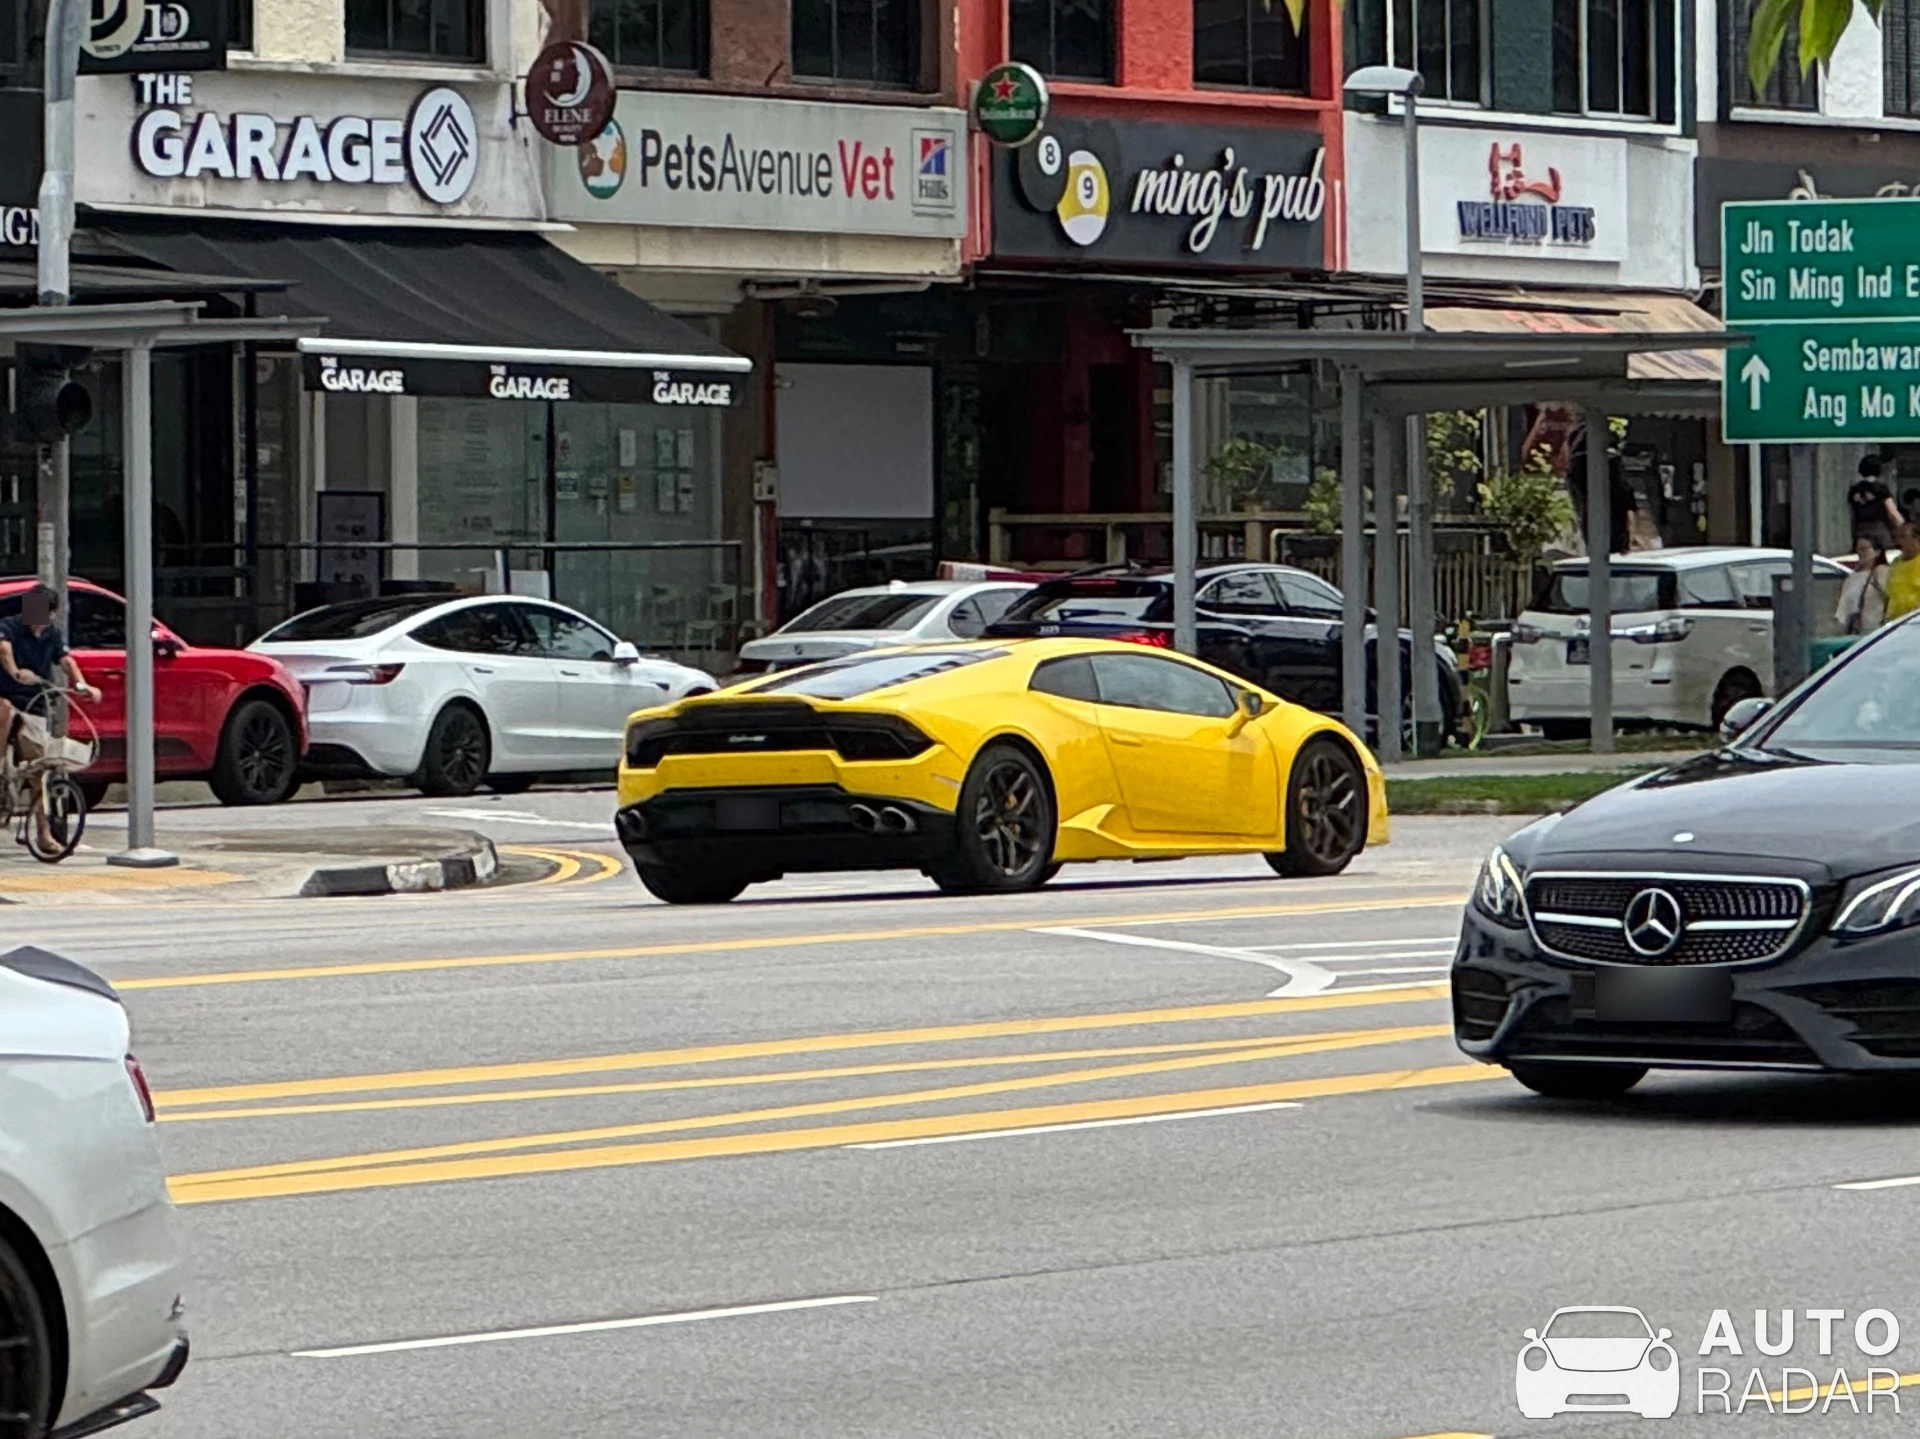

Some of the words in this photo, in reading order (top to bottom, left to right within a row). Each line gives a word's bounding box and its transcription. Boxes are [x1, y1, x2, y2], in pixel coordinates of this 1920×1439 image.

[137, 73, 193, 104] THE
[544, 108, 592, 123] ELENE
[137, 110, 405, 184] GARAGE
[1045, 142, 1056, 165] 8
[1083, 177, 1094, 199] 9
[1131, 147, 1253, 252] ming's
[1252, 147, 1325, 250] pub
[1551, 206, 1596, 243] PETS
[1740, 220, 1774, 254] Jln
[1788, 219, 1854, 253] Todak
[1741, 268, 1776, 300] Sin
[1789, 267, 1845, 308] Ming
[1857, 265, 1892, 298] Ind
[321, 369, 404, 392] GARAGE
[490, 377, 570, 399] GARAGE
[653, 383, 731, 405] GARAGE
[1803, 386, 1847, 427] Ang
[1861, 385, 1895, 418] Mo
